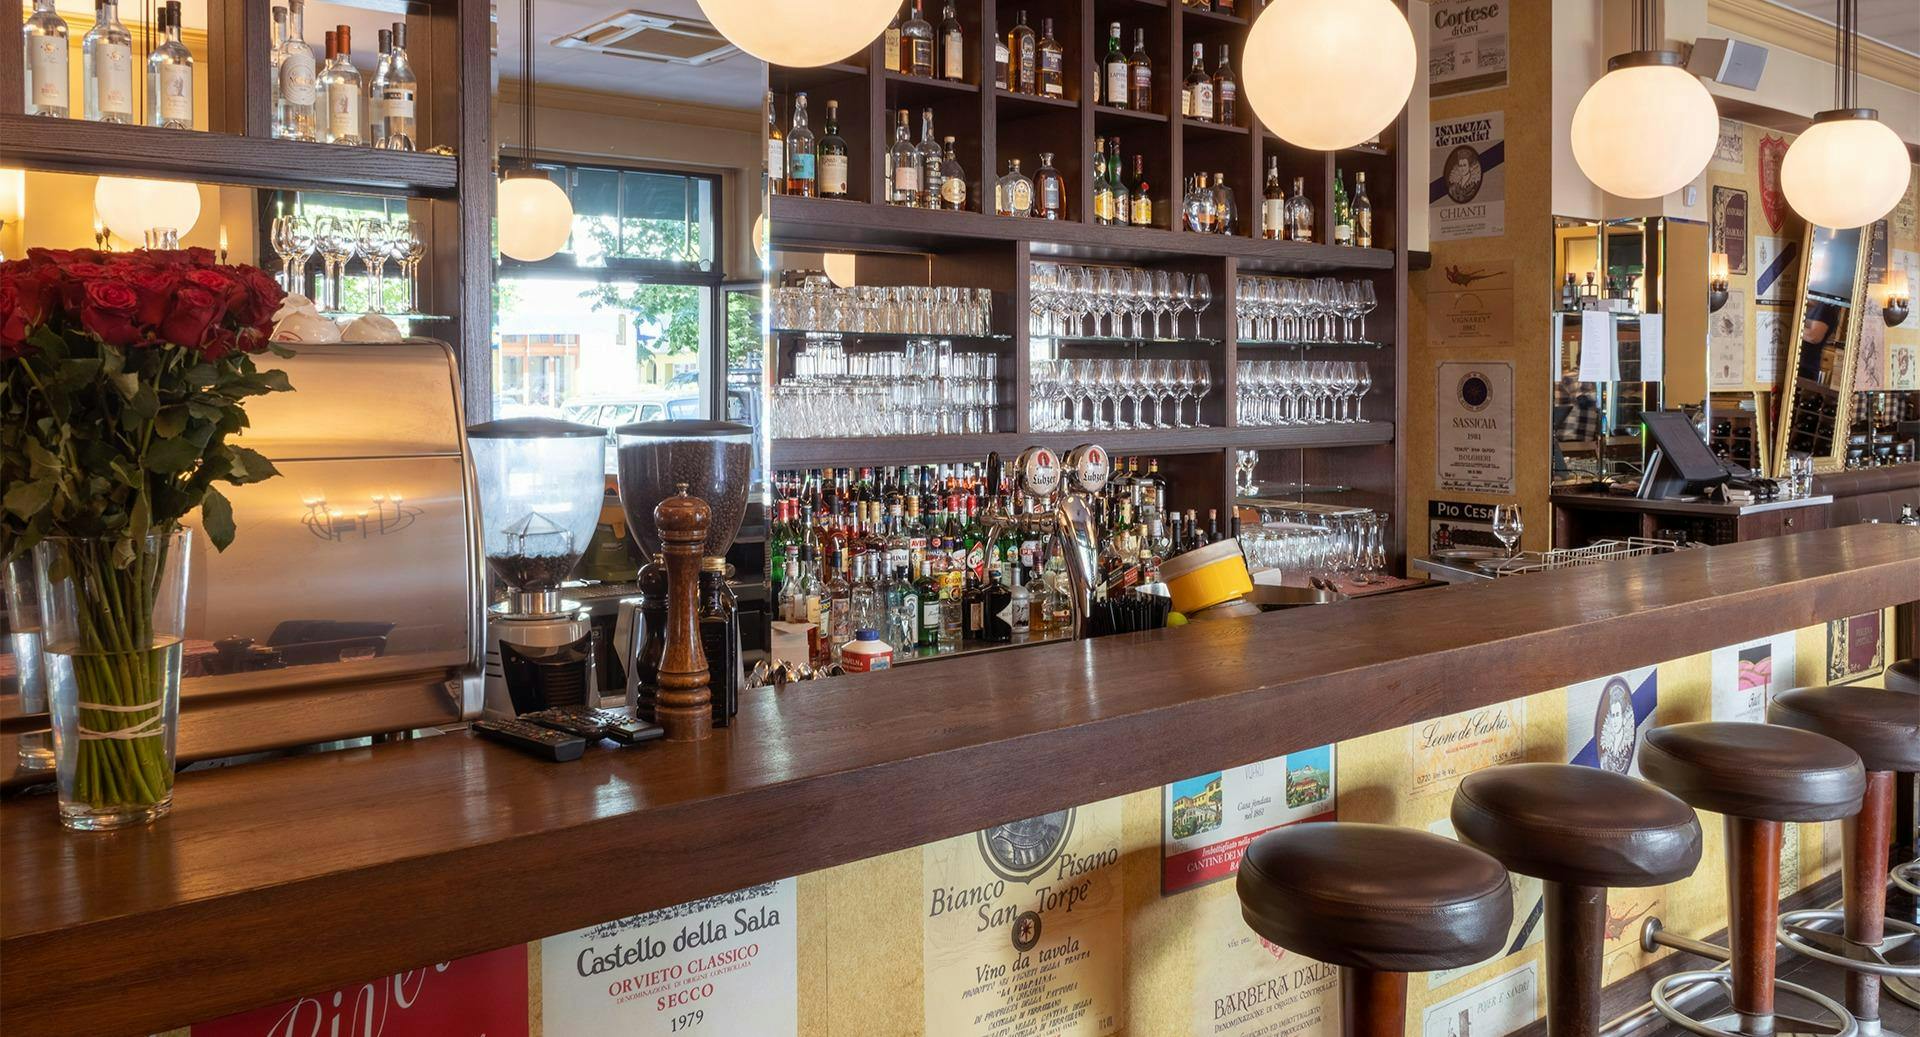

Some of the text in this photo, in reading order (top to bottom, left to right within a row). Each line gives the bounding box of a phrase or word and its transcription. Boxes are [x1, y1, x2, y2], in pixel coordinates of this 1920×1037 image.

[1434, 3, 1499, 29] Cortese
[1452, 26, 1459, 36] di
[1460, 22, 1479, 35] Gavi
[1440, 205, 1487, 219] CHIANTI
[1452, 417, 1497, 429] SASSICAIA
[1421, 720, 1456, 750] Leone
[1056, 847, 1119, 881] Pisano
[1187, 854, 1224, 873] CANTINE
[929, 880, 1005, 918] Bianco
[977, 903, 1018, 933] San
[576, 905, 780, 977] Castello della Sala
[608, 943, 759, 998] ORVIETO CLASSICO
[976, 936, 1080, 985] Vino da tavola
[656, 983, 715, 1012] SECCO
[1213, 973, 1290, 1021] BARBERA
[671, 1009, 705, 1033] 1979
[1214, 1007, 1265, 1034] DENOMINAZIONE
